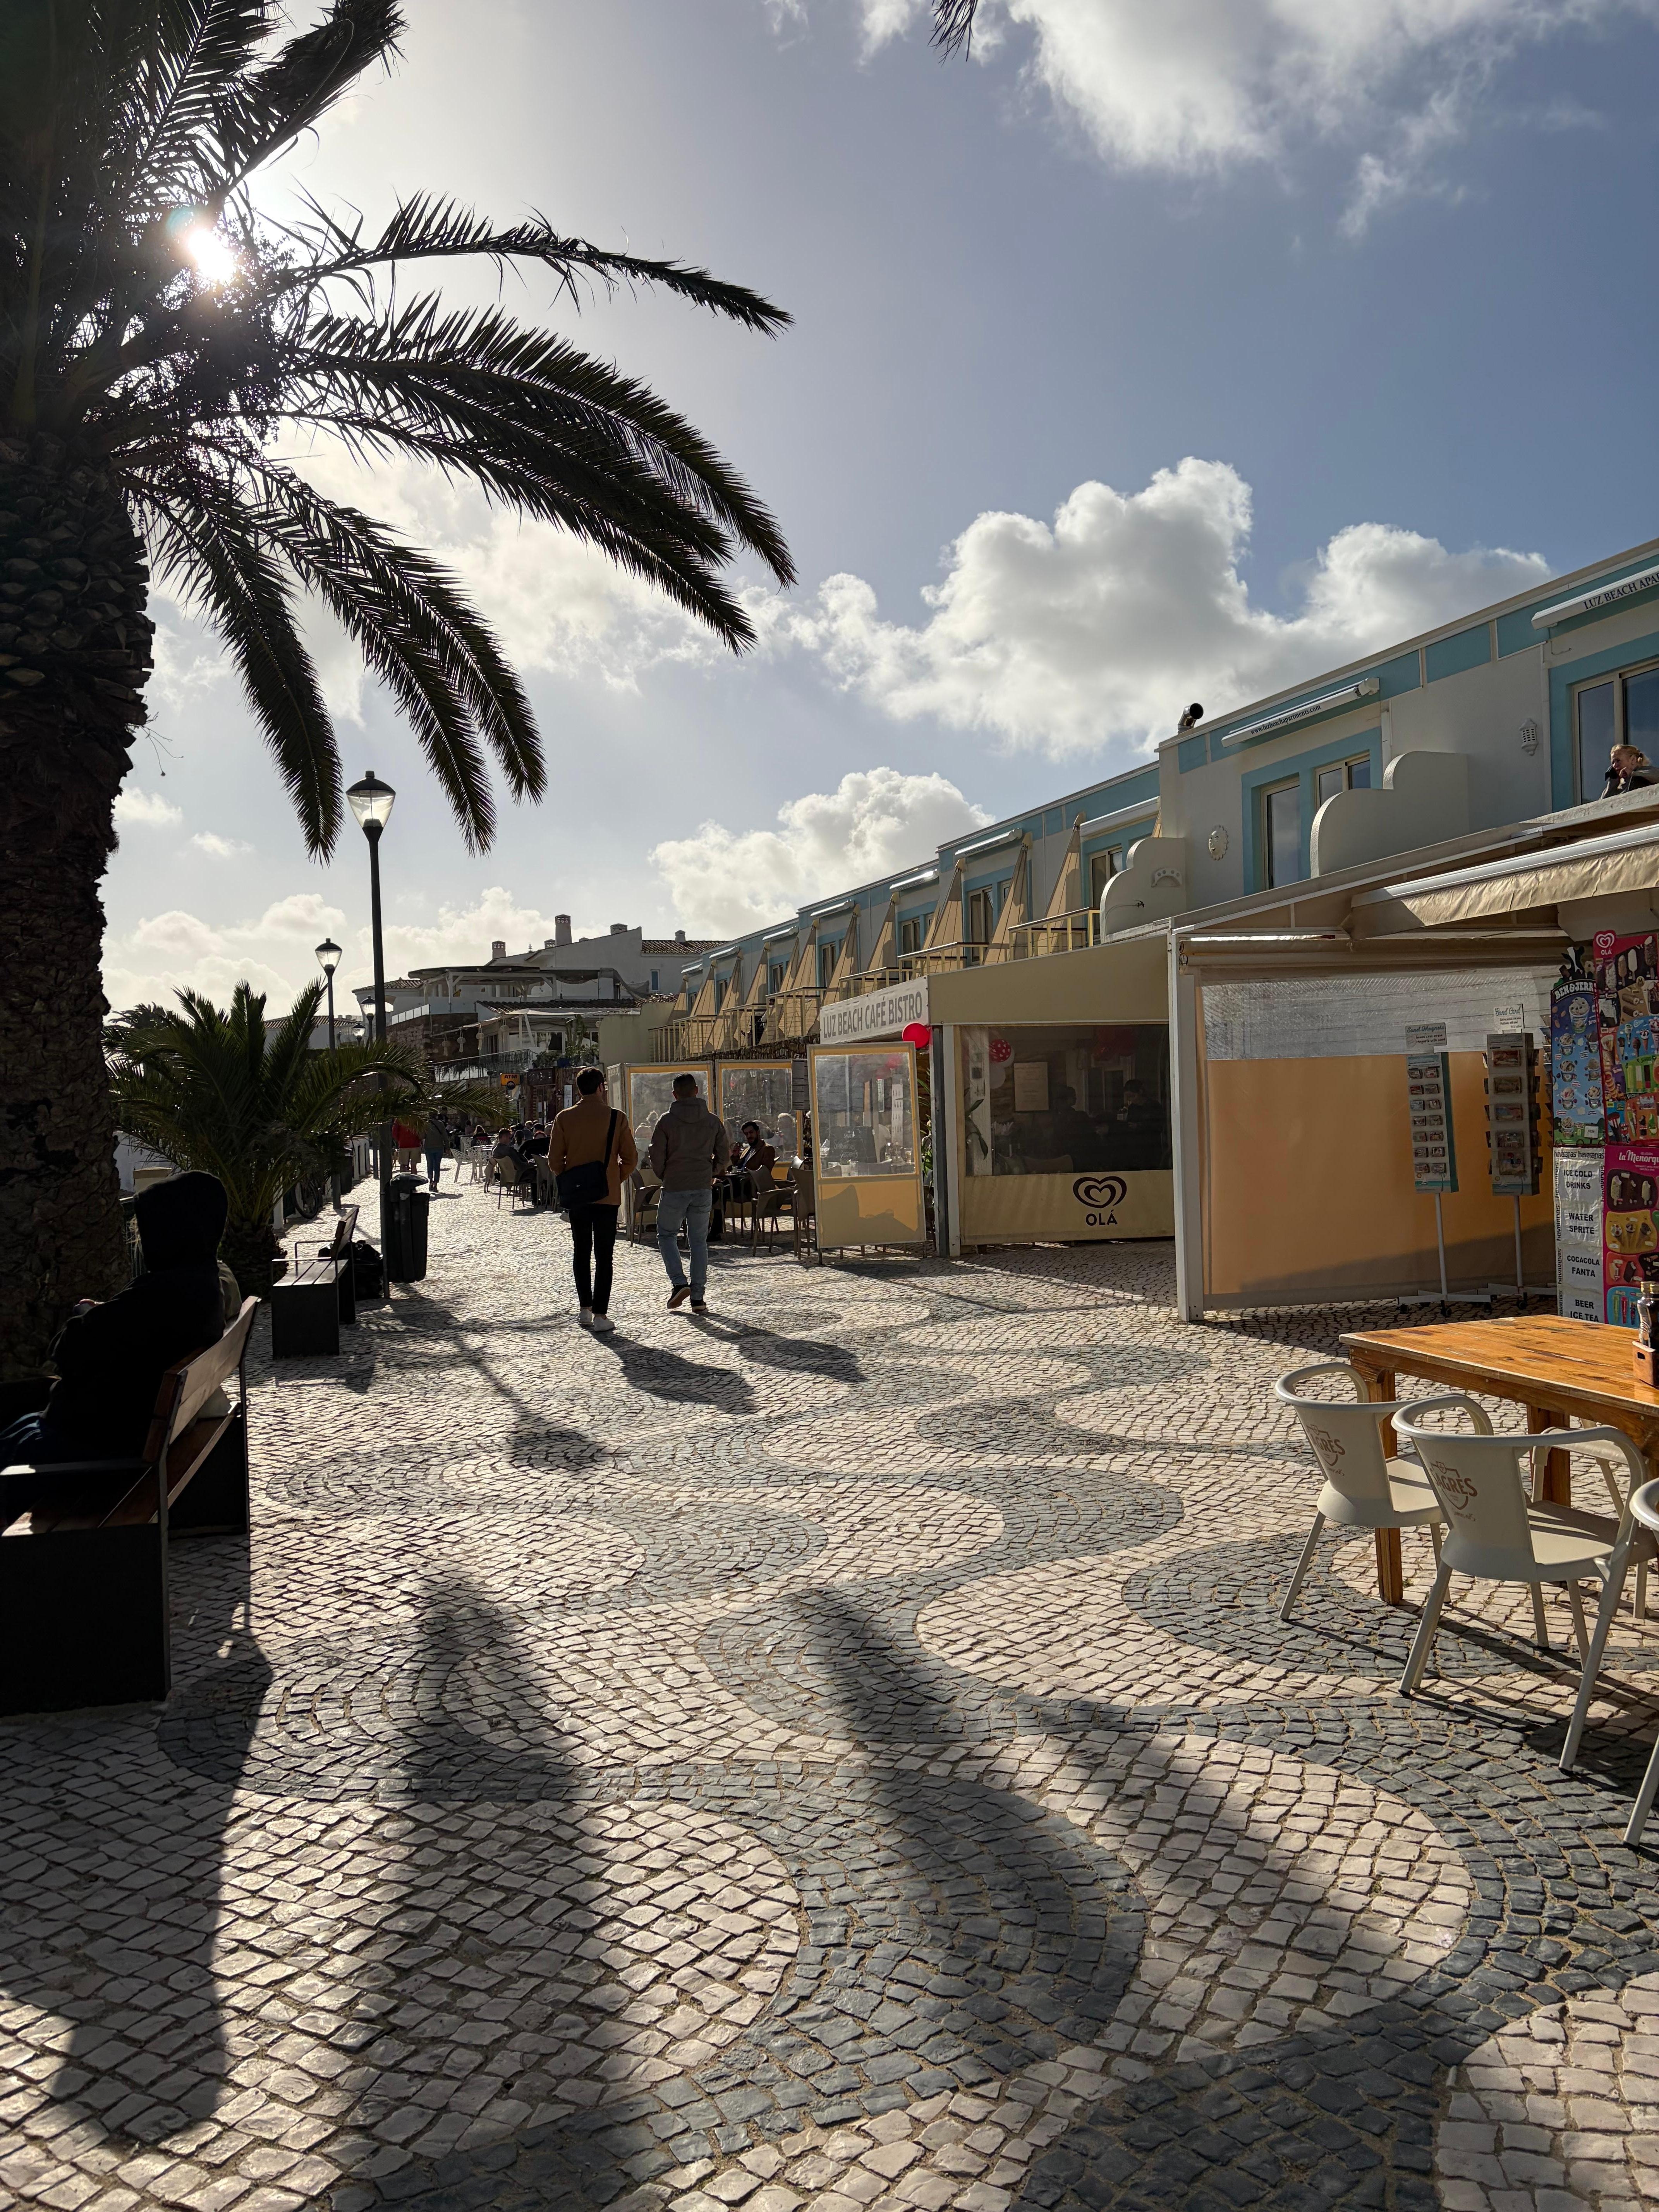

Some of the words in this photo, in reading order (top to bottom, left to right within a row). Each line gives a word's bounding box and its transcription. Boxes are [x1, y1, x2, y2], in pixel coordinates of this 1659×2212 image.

[1583, 596, 1603, 610] LUZ
[1604, 582, 1637, 601] BEACH
[1250, 705, 1321, 734] www.luzbeachapartments.com
[823, 1014, 836, 1038] LUZ
[838, 1007, 862, 1036] BEACH
[865, 996, 886, 1029] CAFÉ
[889, 991, 922, 1025] BISTRO
[1495, 1008, 1508, 1016] Sand
[1509, 1006, 1522, 1015] Card
[1619, 1152, 1626, 1160] la
[1085, 1209, 1118, 1226] OLÁ
[1568, 1212, 1594, 1221] WATER
[1569, 1225, 1595, 1234] SPRITE
[1567, 1255, 1600, 1266] COCACOLA
[1572, 1267, 1595, 1277] FANTA
[1575, 1299, 1594, 1309] BEER
[1570, 1311, 1583, 1319] ICE
[1585, 1313, 1599, 1322] TEA
